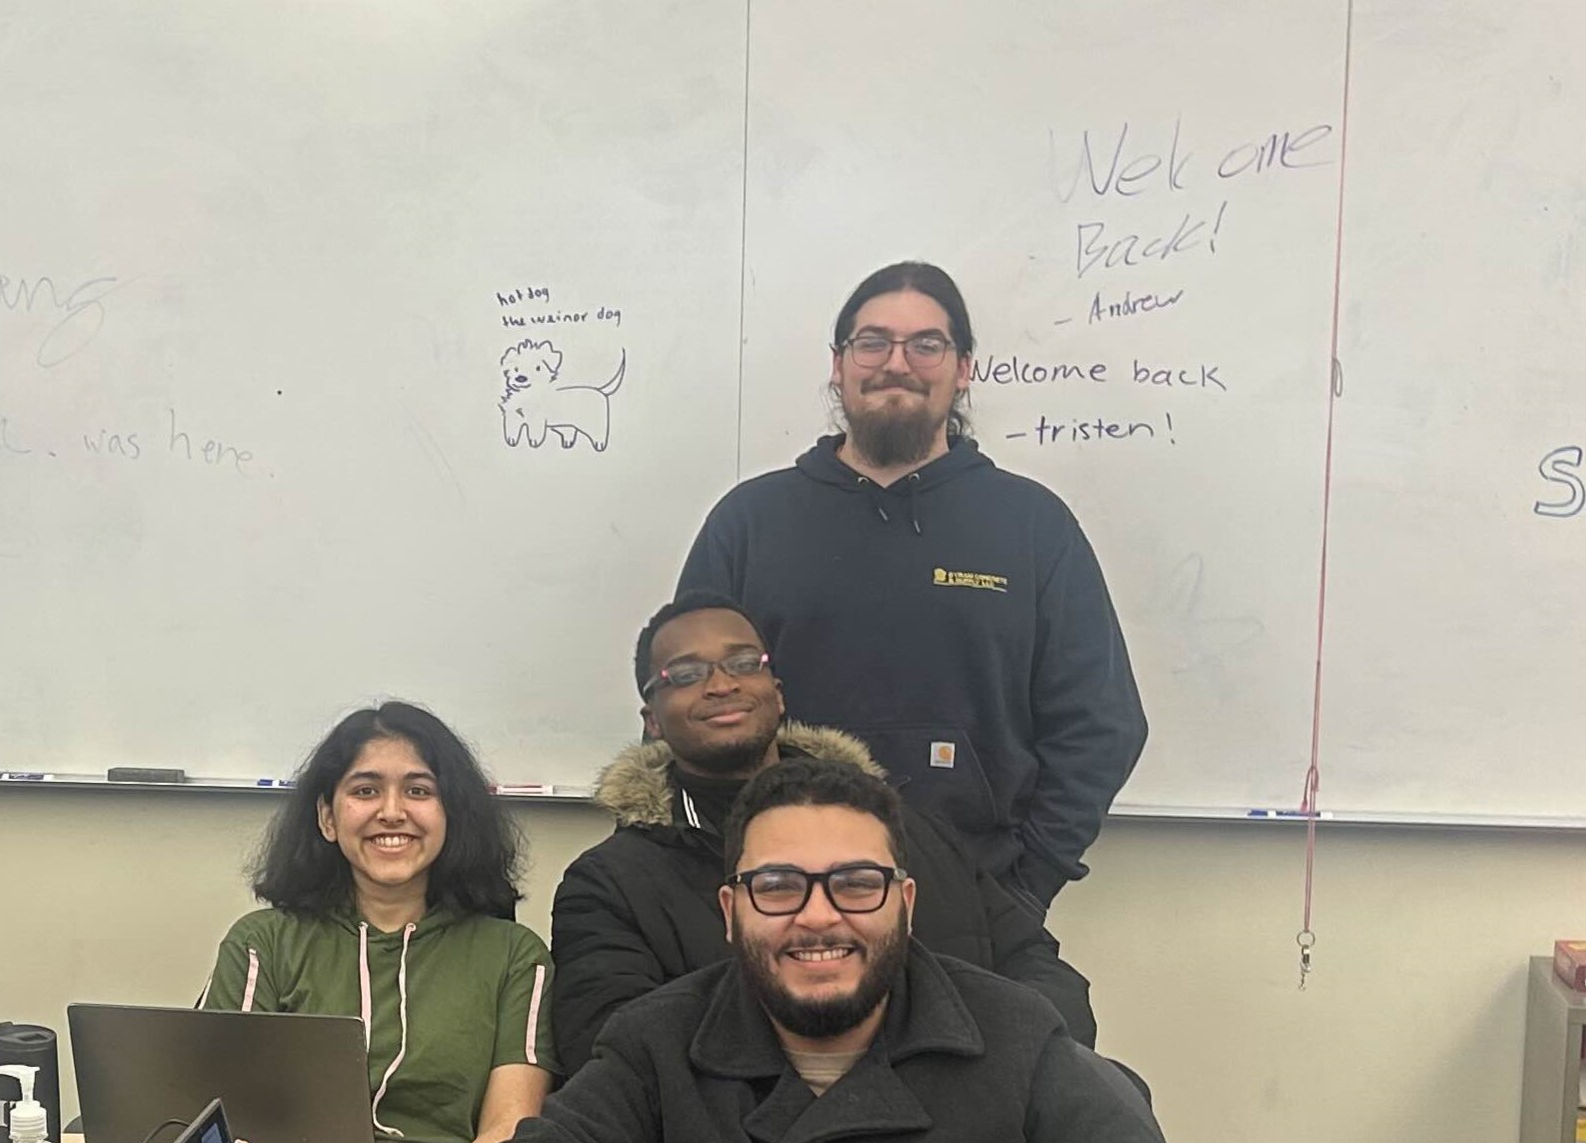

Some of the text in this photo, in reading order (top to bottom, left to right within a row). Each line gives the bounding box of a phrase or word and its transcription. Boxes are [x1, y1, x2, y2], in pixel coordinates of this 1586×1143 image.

[1076, 200, 1228, 278] Back!
[502, 315, 526, 328] the
[596, 306, 622, 328] dog
[1087, 289, 1184, 325] Andrew
[968, 354, 1228, 392] Welcome back
[83, 429, 141, 461] was
